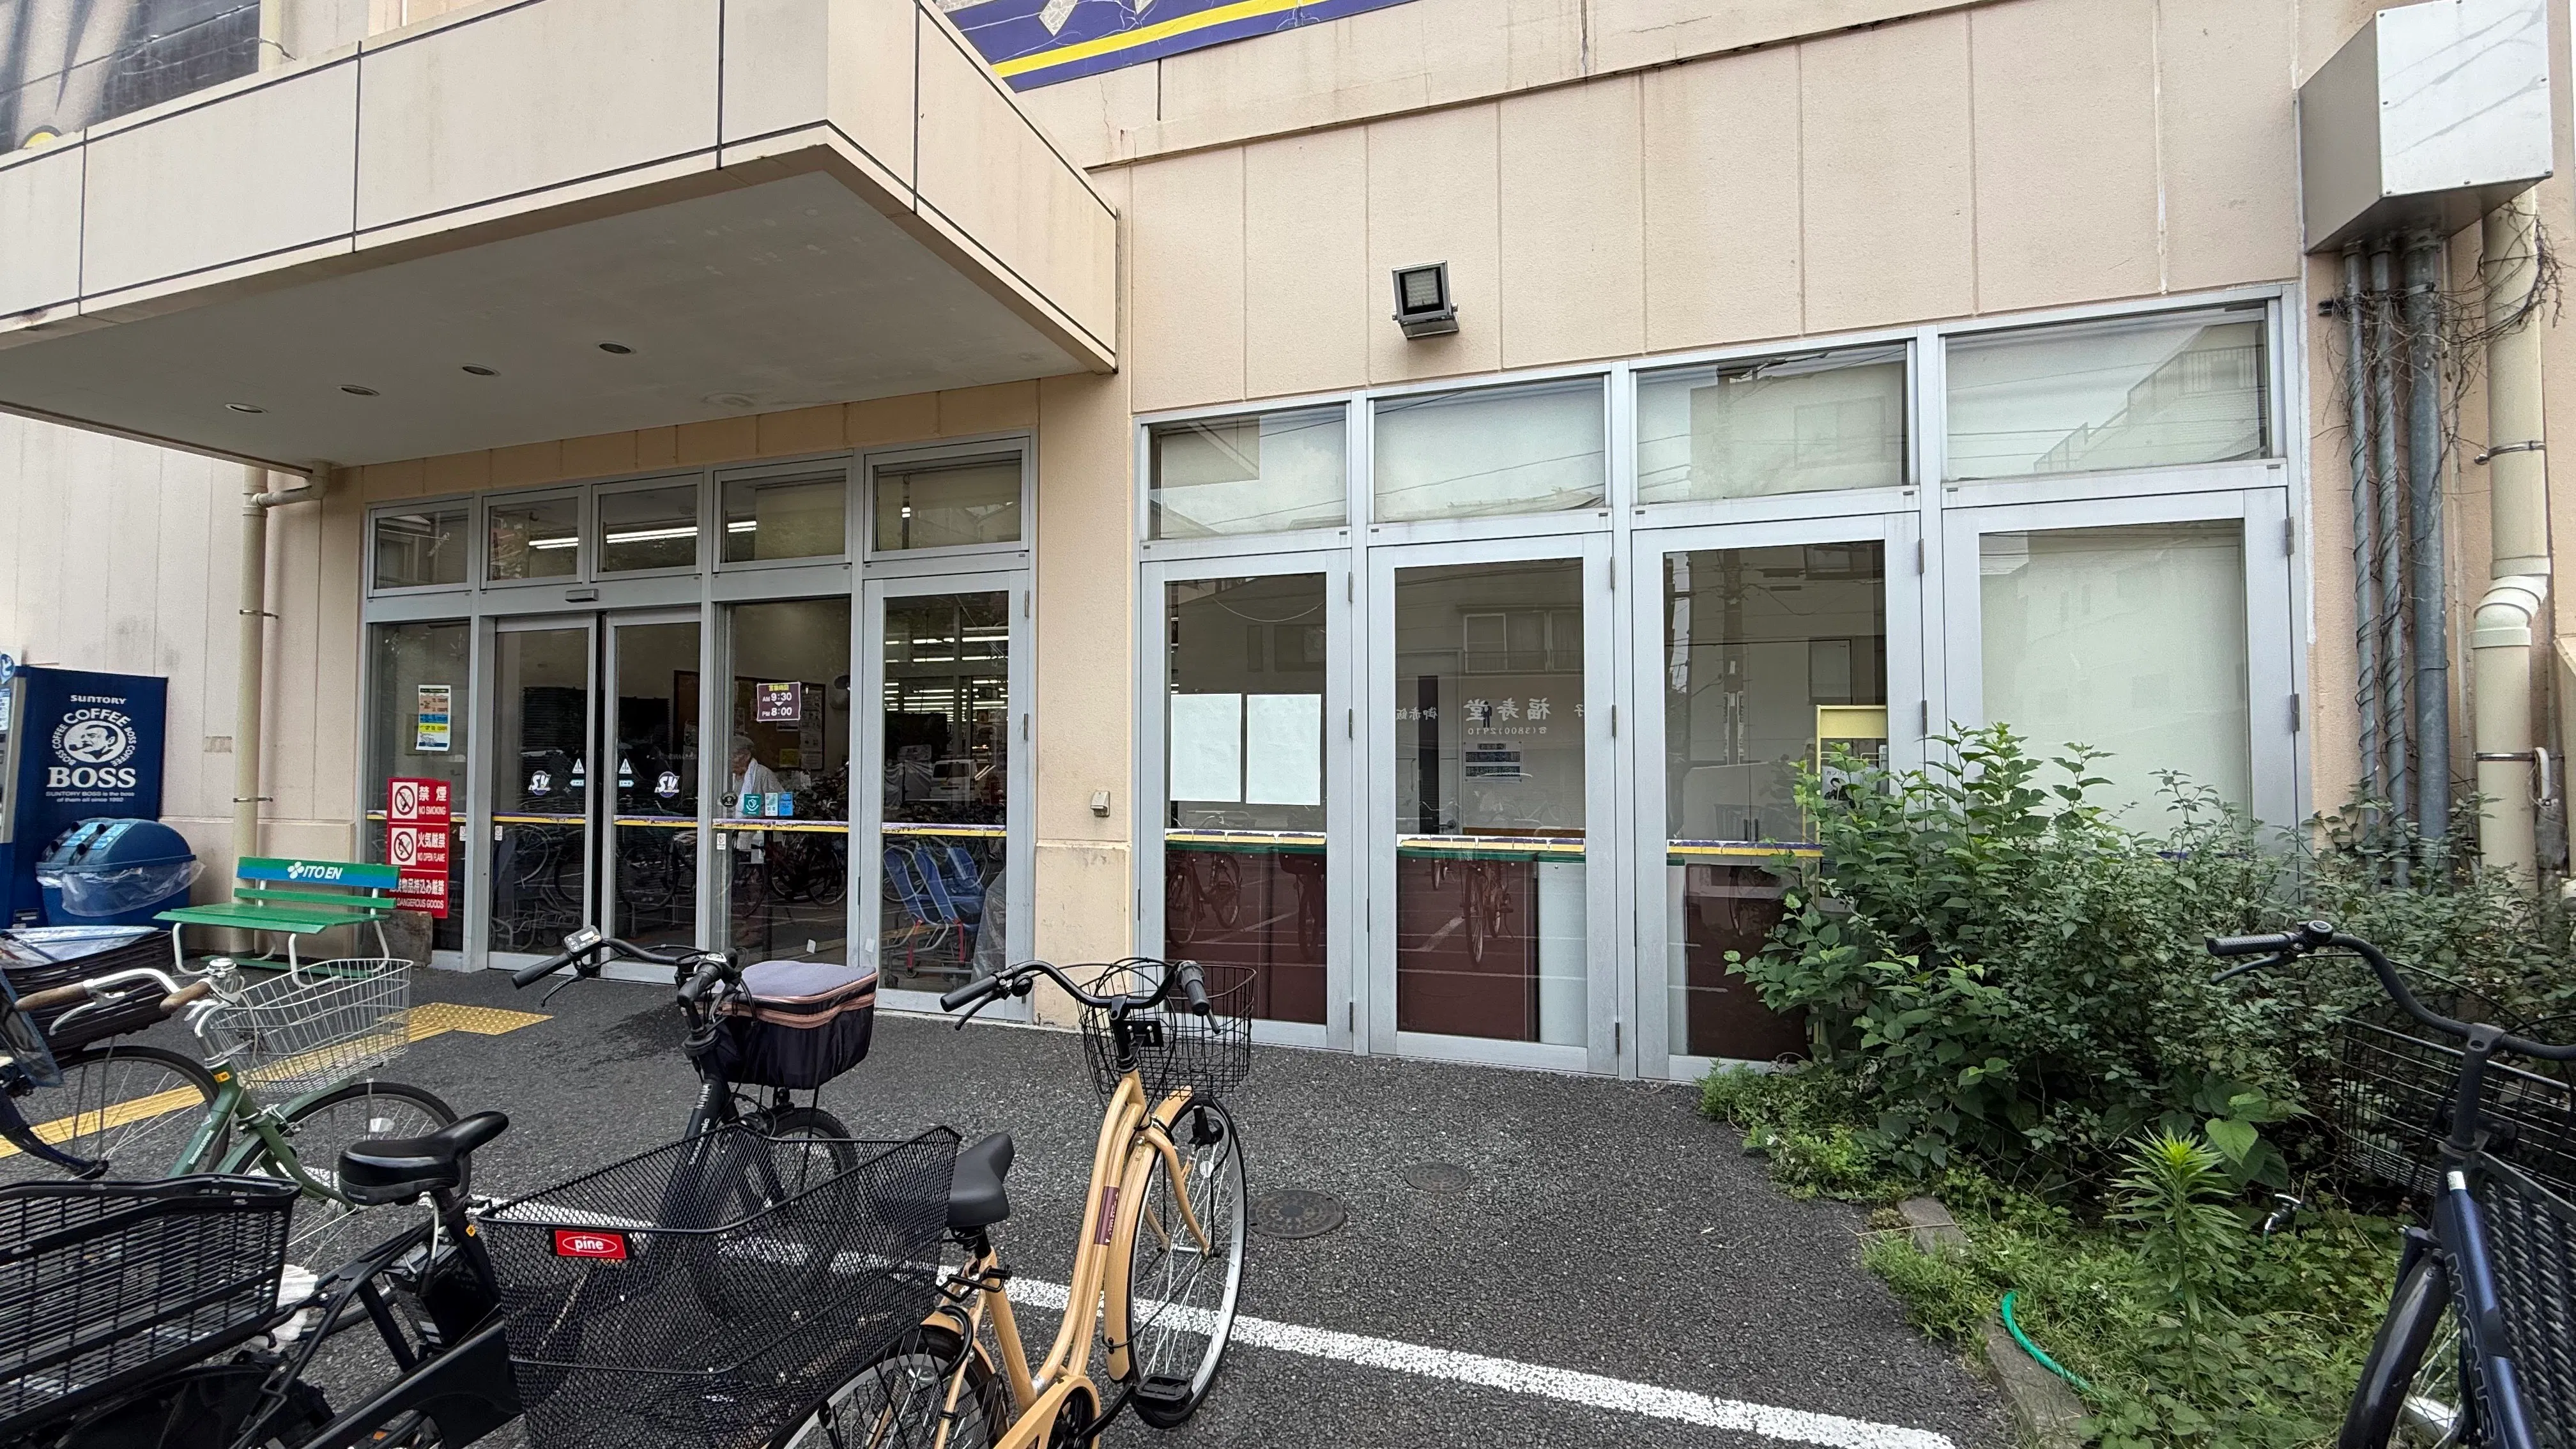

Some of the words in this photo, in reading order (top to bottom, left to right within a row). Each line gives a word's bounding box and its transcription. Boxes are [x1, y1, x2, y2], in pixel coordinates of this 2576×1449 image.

[70, 694, 126, 704] SUNTORY
[770, 692, 792, 702] 9:30
[63, 708, 132, 727] COFFEE
[770, 707, 792, 716] 8:00
[52, 723, 68, 749] COFFEE
[125, 726, 137, 744] BOSS
[55, 749, 77, 766] BOSS
[110, 745, 135, 767] COFFEE
[46, 767, 136, 788] BOSS
[418, 786, 447, 801] 禁煙
[418, 806, 425, 815] NO
[425, 806, 446, 815] SMOKING
[417, 832, 445, 848] 火気厳禁
[397, 897, 426, 908] DANGEROUS
[426, 899, 444, 909] GOODS
[575, 1236, 604, 1252] pine
